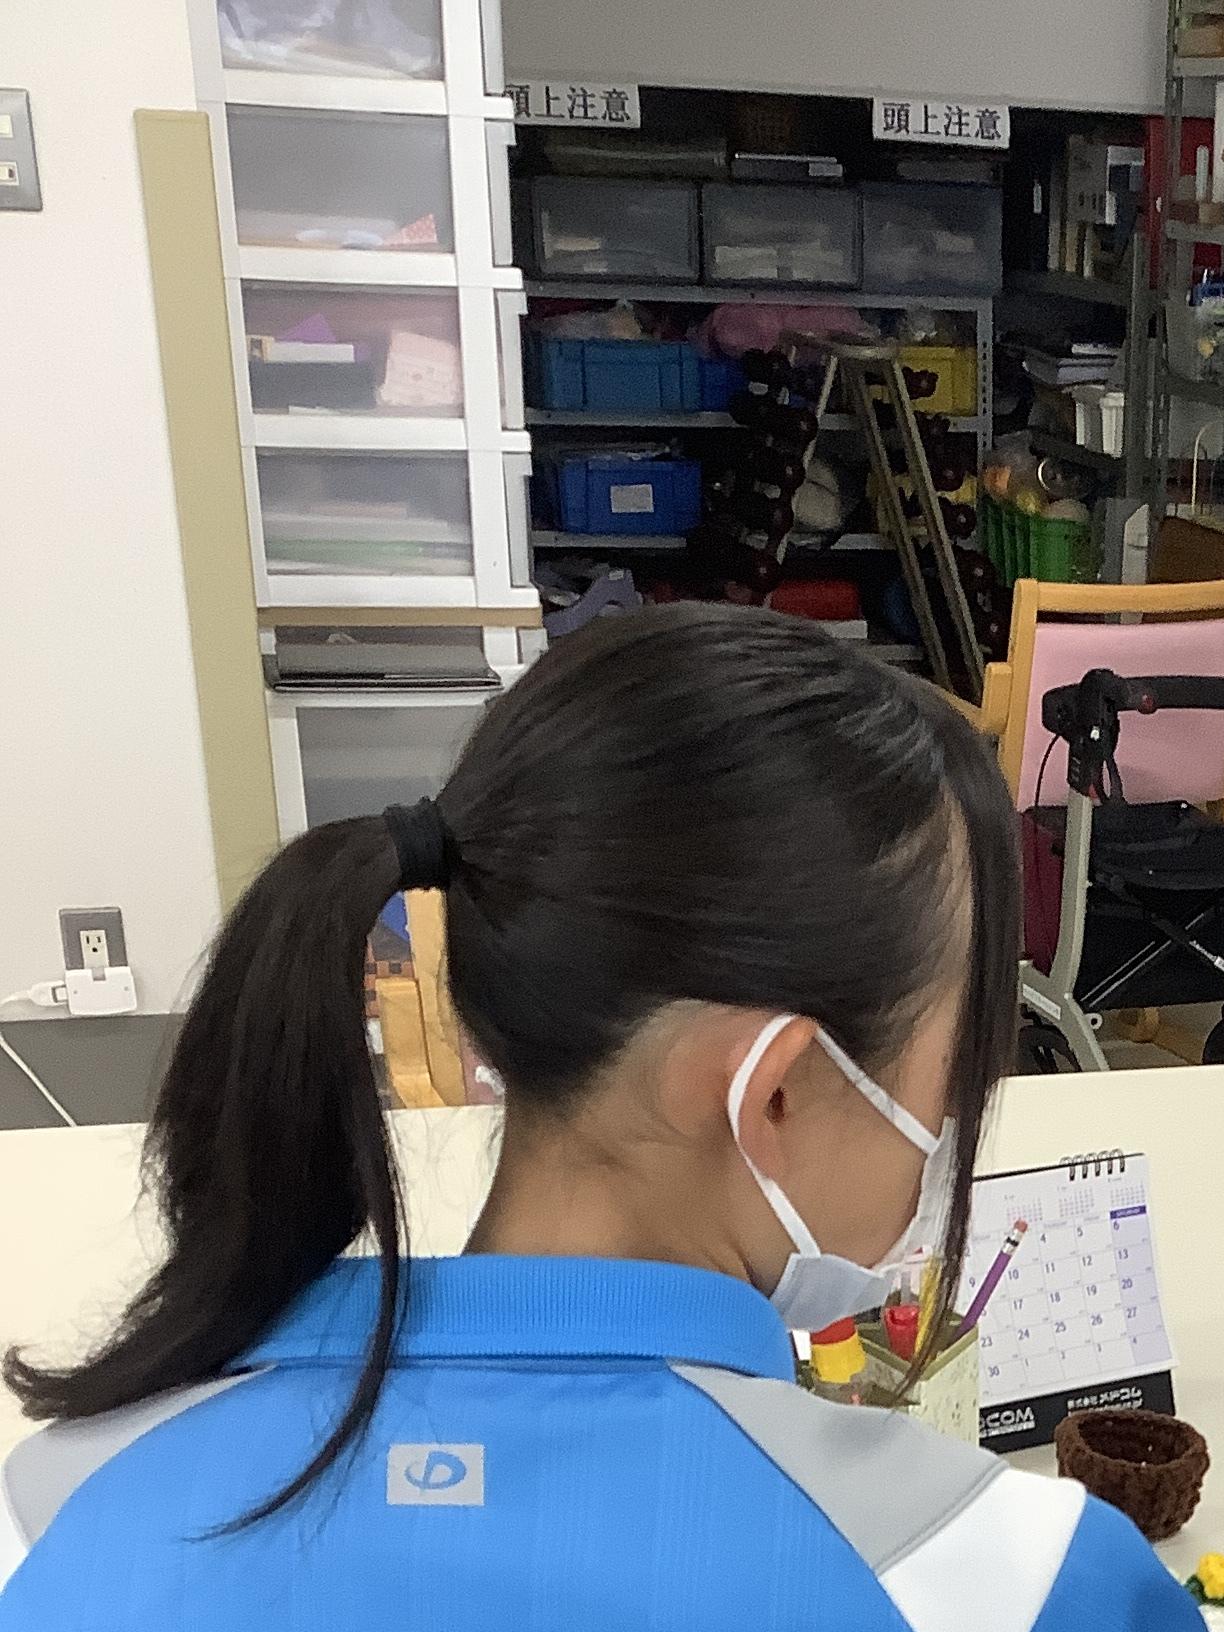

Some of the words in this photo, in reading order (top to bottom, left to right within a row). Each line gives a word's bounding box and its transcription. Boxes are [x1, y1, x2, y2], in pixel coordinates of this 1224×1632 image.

[882, 102, 1001, 140] 頭上注意
[1040, 1233, 1046, 1243] 4
[1077, 1227, 1083, 1238] 5
[1113, 1221, 1120, 1231] 6
[968, 1277, 975, 1288] 9
[1008, 1268, 1019, 1280] 10
[1045, 1262, 1055, 1274] 11
[1082, 1255, 1093, 1267] 12
[1118, 1248, 1128, 1260] 13
[1013, 1298, 1023, 1310] 17
[1050, 1292, 1061, 1303] 18
[1086, 1285, 1097, 1296] 19
[1121, 1278, 1133, 1290] 20
[981, 1336, 992, 1348] 23
[1017, 1328, 1030, 1340] 24
[1055, 1321, 1066, 1333] 25
[1091, 1314, 1103, 1326] 26
[1126, 1306, 1137, 1319] 27
[988, 1365, 1000, 1378] 30
